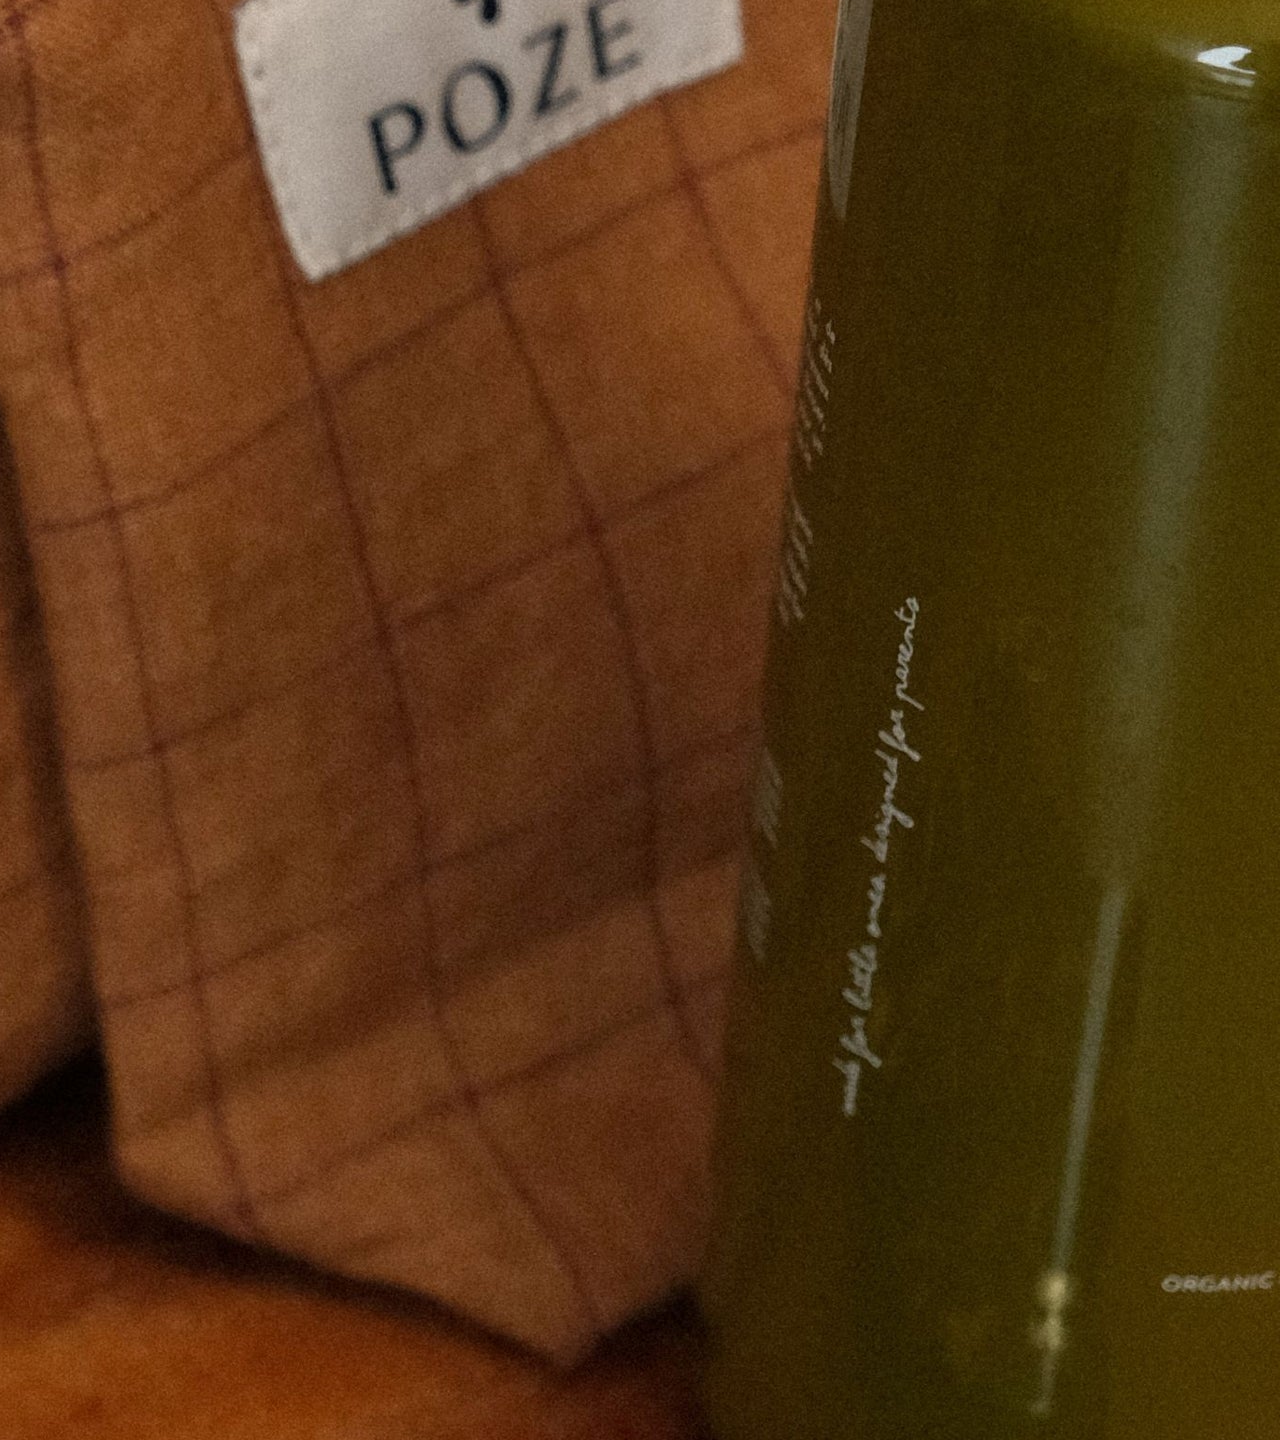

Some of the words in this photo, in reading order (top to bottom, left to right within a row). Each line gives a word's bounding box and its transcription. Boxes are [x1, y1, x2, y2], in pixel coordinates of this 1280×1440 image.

[894, 597, 925, 711] parents
[878, 709, 921, 761] for
[1161, 1271, 1277, 1293] ORGANIC
